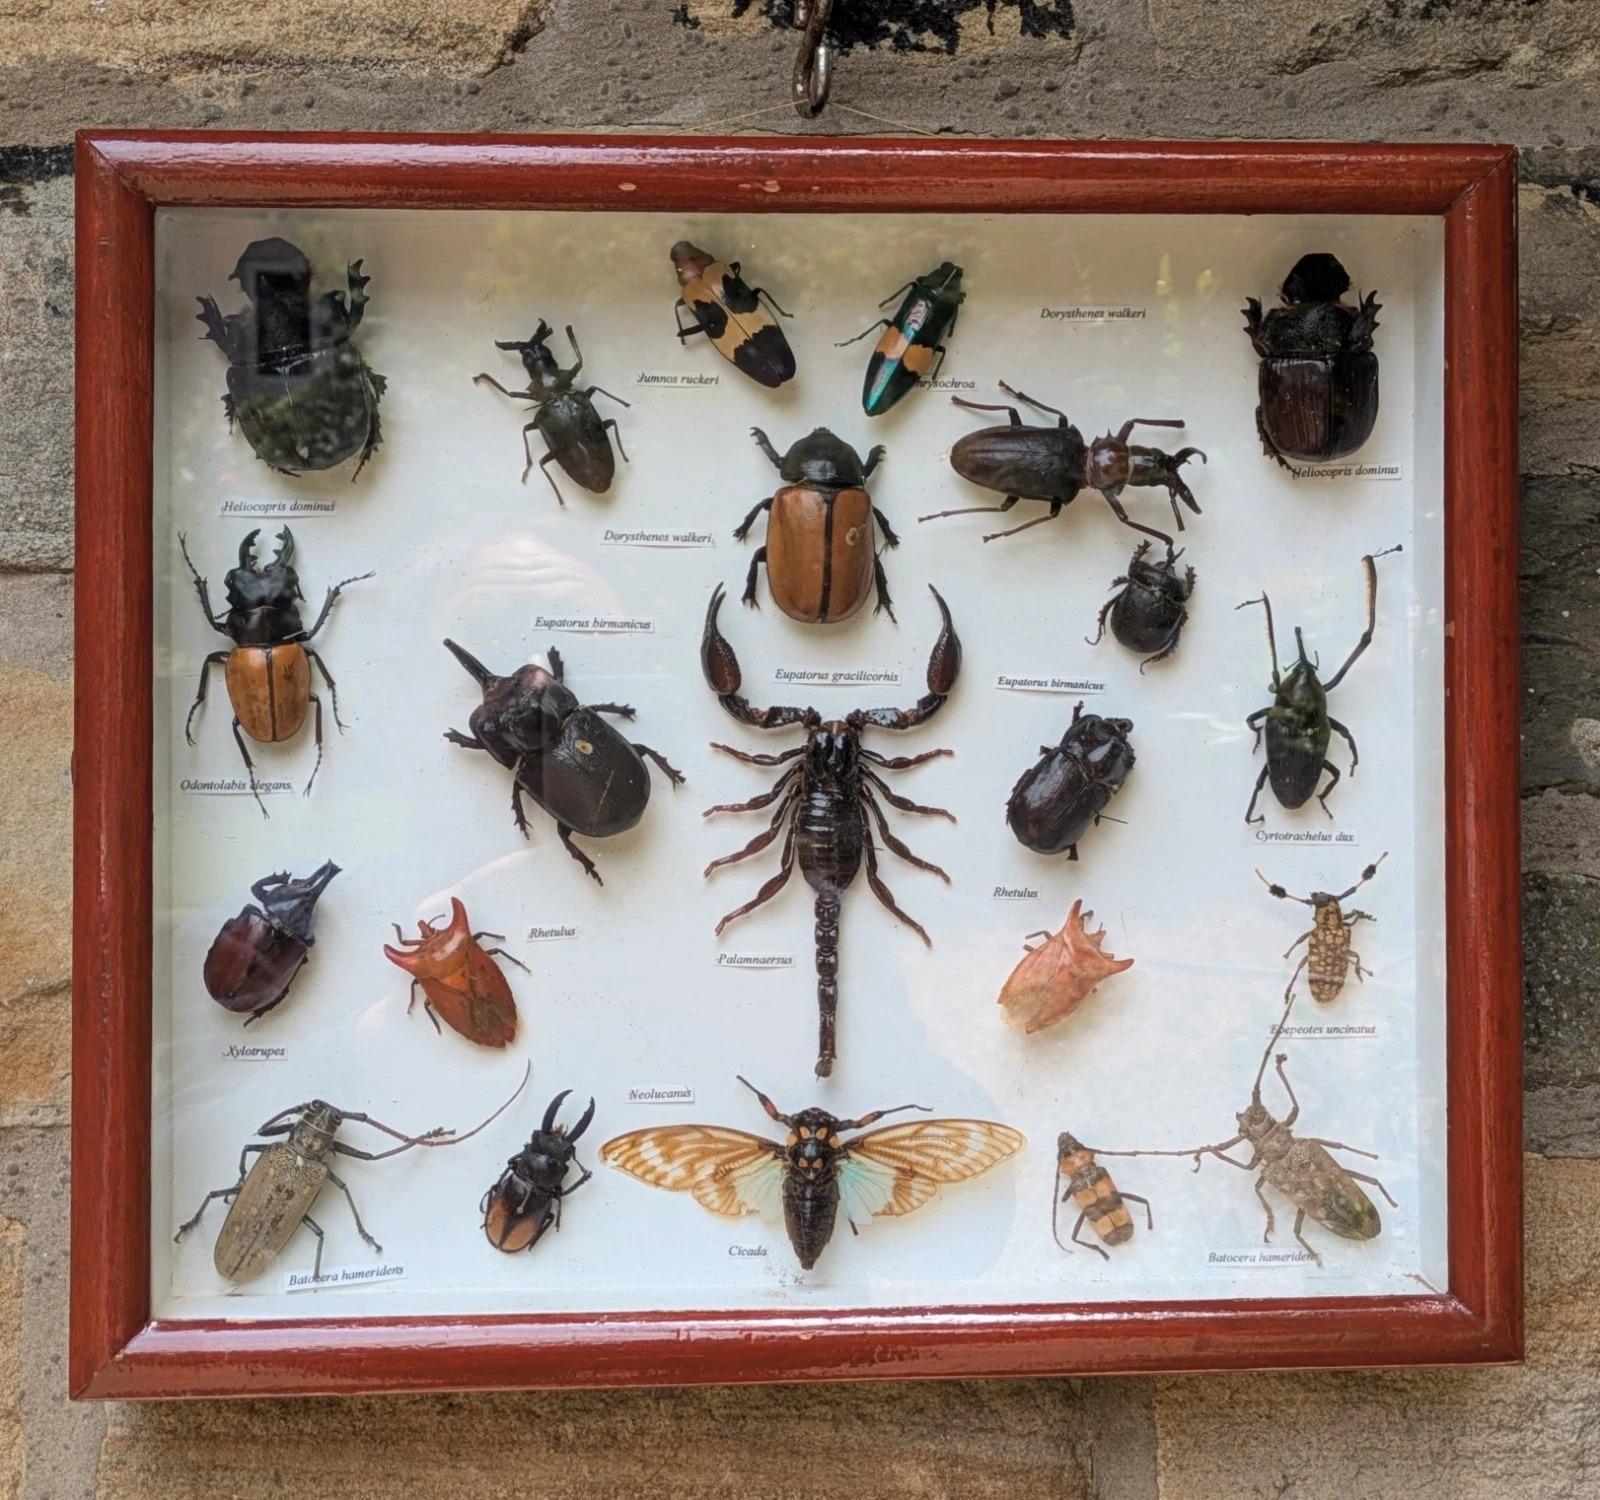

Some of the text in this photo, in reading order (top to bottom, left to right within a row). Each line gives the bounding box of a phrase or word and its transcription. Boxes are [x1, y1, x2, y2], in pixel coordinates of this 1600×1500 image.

[1041, 308, 1146, 320] Dorysthenes walkeri
[638, 373, 719, 385] Jumnos ruckeri
[912, 378, 975, 390] hrysochroa
[1292, 465, 1399, 479] Heliocopris dominus
[224, 500, 336, 514] Heliocopris dominus
[604, 530, 669, 543] Dorysthenes
[535, 616, 652, 629] Eupatorus birmanicus
[775, 668, 899, 683] Eupatorus gracilicornis
[998, 676, 1105, 690] Eupatorus birmanicus
[180, 778, 246, 791] Odontolabis
[1255, 829, 1354, 843] Cyrtotrachelus dux
[992, 886, 1039, 899] Rhetulus
[529, 926, 577, 939] Rhetulus
[718, 953, 793, 965] Palamnaersus
[1326, 1024, 1376, 1034] uncinatus
[226, 1045, 286, 1059] Xylotrupes
[629, 1088, 692, 1100] Neolucanus
[728, 1244, 768, 1257] Cicada
[1208, 1250, 1317, 1263] Batocera hameriden
[289, 1272, 339, 1286] Batocera
